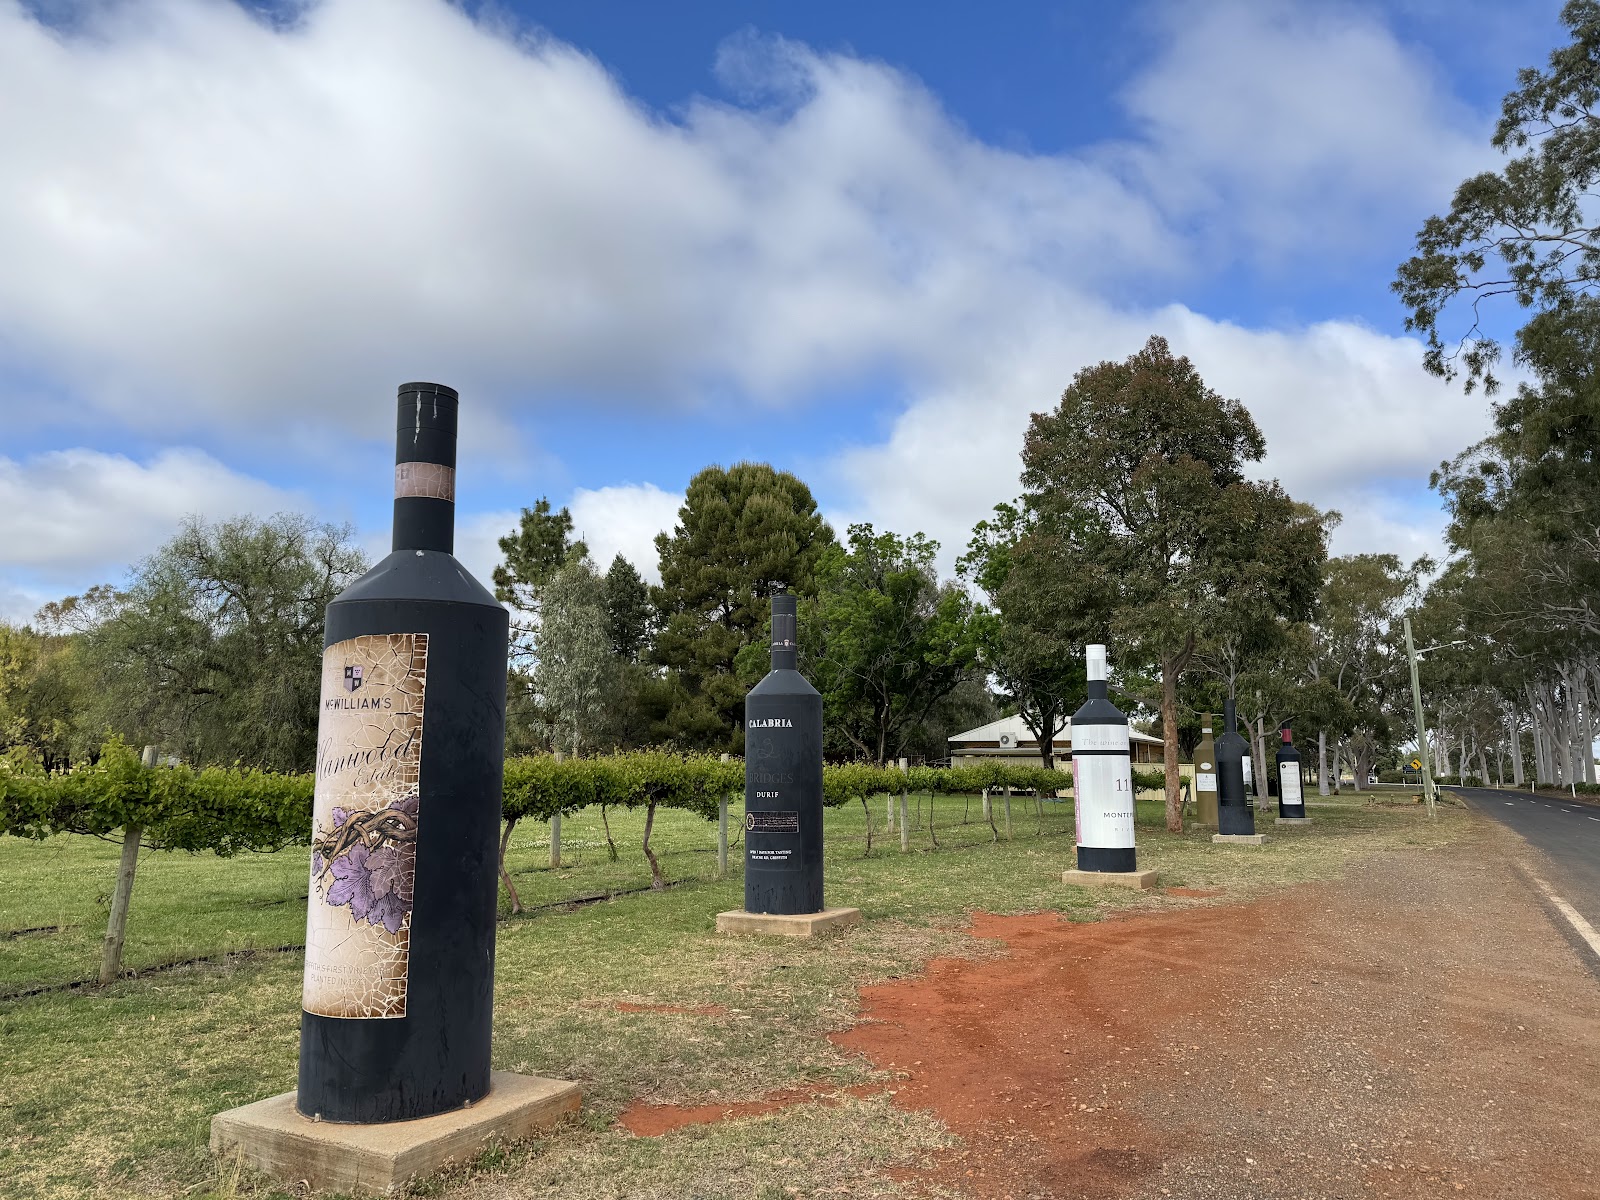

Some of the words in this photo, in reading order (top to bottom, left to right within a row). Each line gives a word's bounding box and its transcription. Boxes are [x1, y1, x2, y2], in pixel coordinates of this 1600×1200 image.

[748, 718, 793, 728] CALABRIA
[353, 765, 400, 788] Estate
[749, 772, 793, 784] BRIDGES
[1116, 778, 1132, 791] 11
[311, 973, 336, 985] PLANTED
